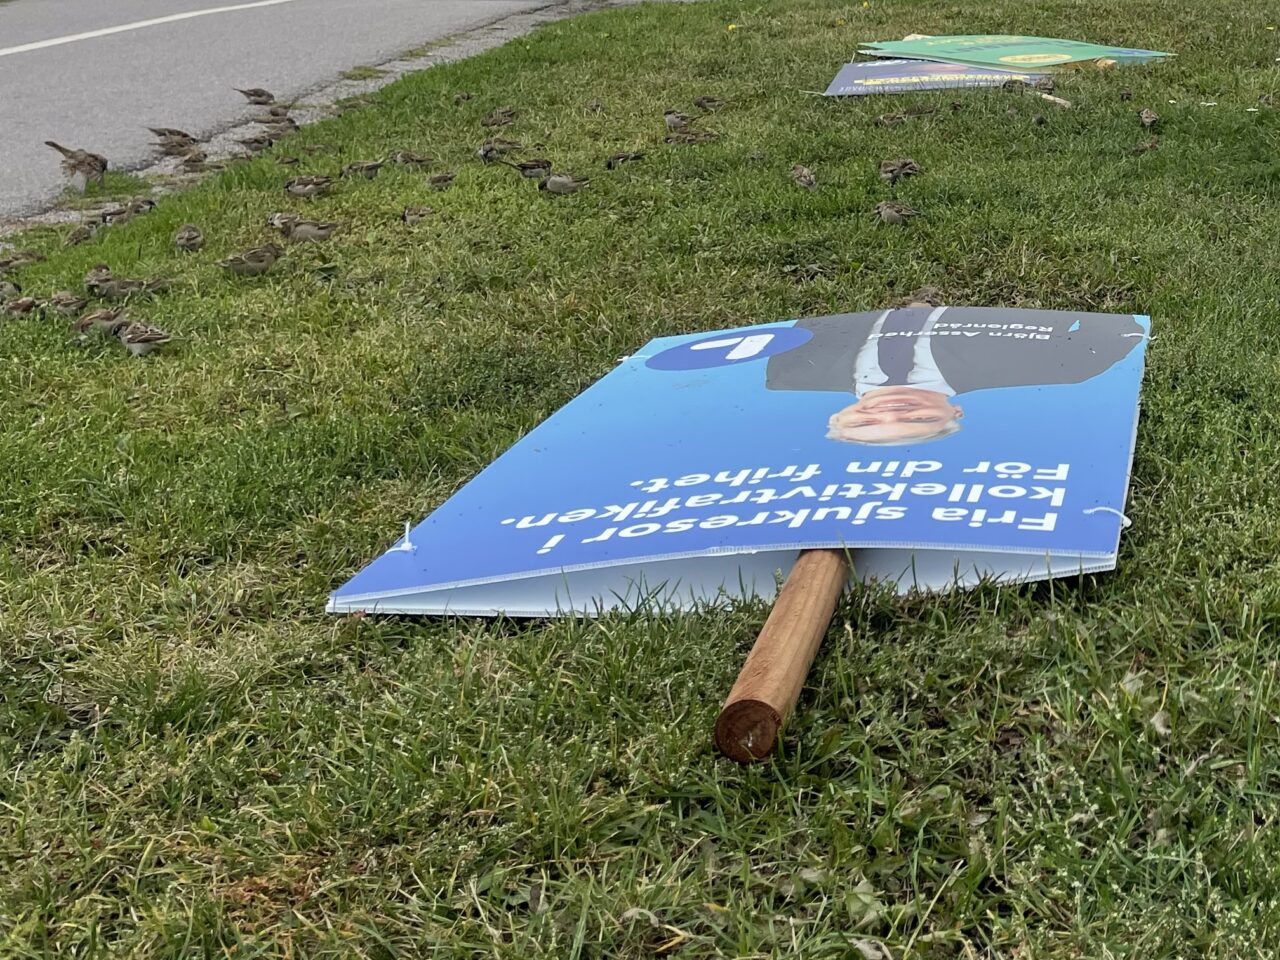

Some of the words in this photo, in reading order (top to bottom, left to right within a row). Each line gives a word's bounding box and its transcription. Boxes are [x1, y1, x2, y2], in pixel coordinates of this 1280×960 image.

[933, 323, 1053, 333] Regionråd
[989, 331, 1050, 340] Björn
[630, 463, 822, 493] frihet.
[846, 460, 943, 478] din
[963, 461, 1070, 481] För
[501, 482, 1067, 529] kollektivtrafiken.
[582, 501, 908, 544] sjukresor
[932, 507, 1058, 532] Fria
[536, 534, 565, 554] i
